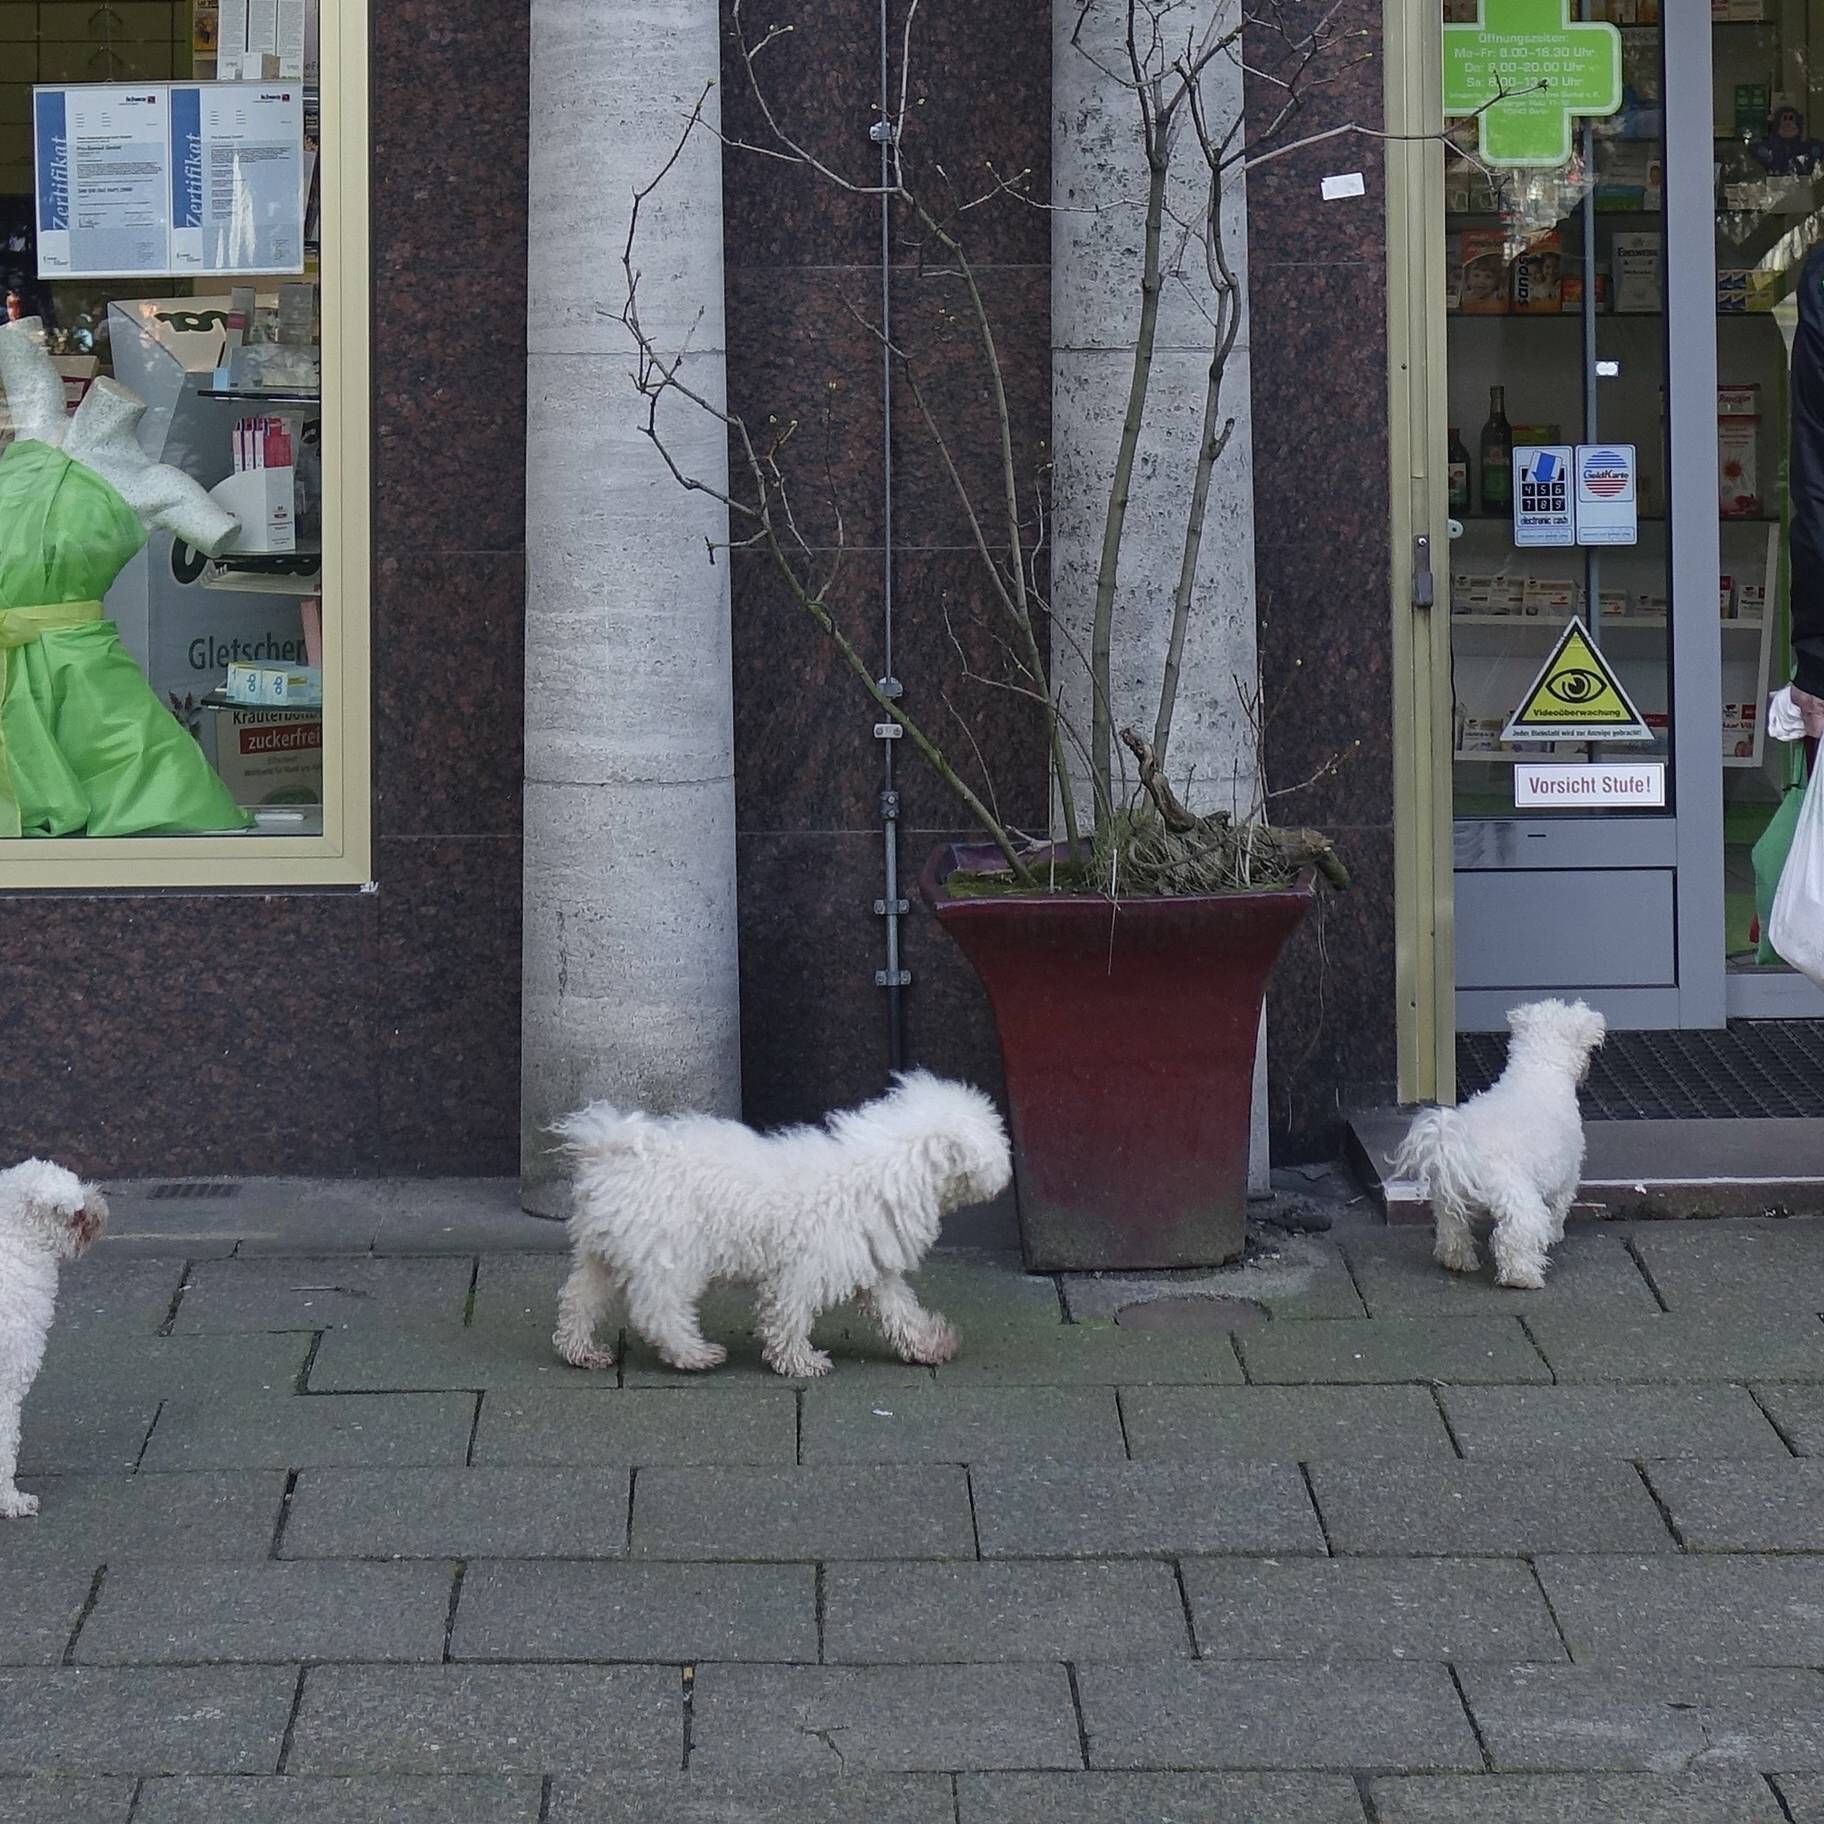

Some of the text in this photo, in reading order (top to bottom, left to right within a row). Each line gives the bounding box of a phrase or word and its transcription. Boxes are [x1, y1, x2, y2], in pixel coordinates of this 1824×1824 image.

[51, 135, 69, 230] Zertifikat
[185, 132, 203, 227] Zertifikat
[1533, 709, 1621, 718] Videoüberwachung
[248, 727, 321, 750] zuckerfrei
[1528, 776, 1651, 794] Vorsicht Stufe!
